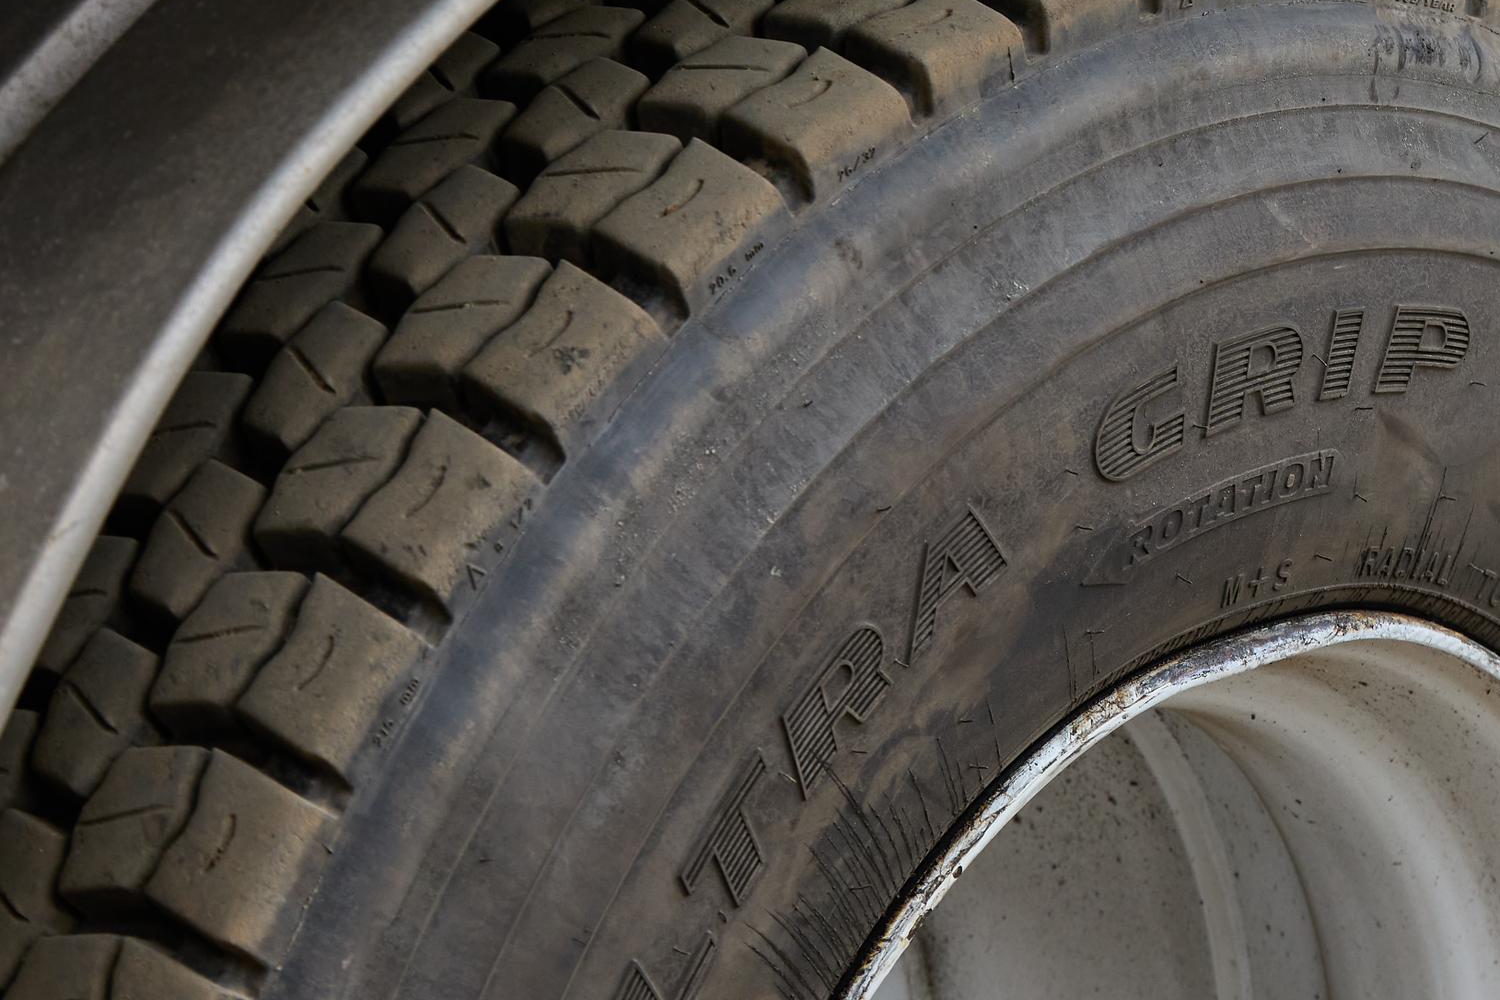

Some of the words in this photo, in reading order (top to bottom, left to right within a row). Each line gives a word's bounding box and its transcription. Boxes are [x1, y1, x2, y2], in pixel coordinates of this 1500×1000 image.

[1095, 303, 1471, 482] GRIP
[1121, 453, 1338, 573] ROTATION
[1219, 558, 1295, 609] M+S
[1358, 544, 1455, 587] RADIAL
